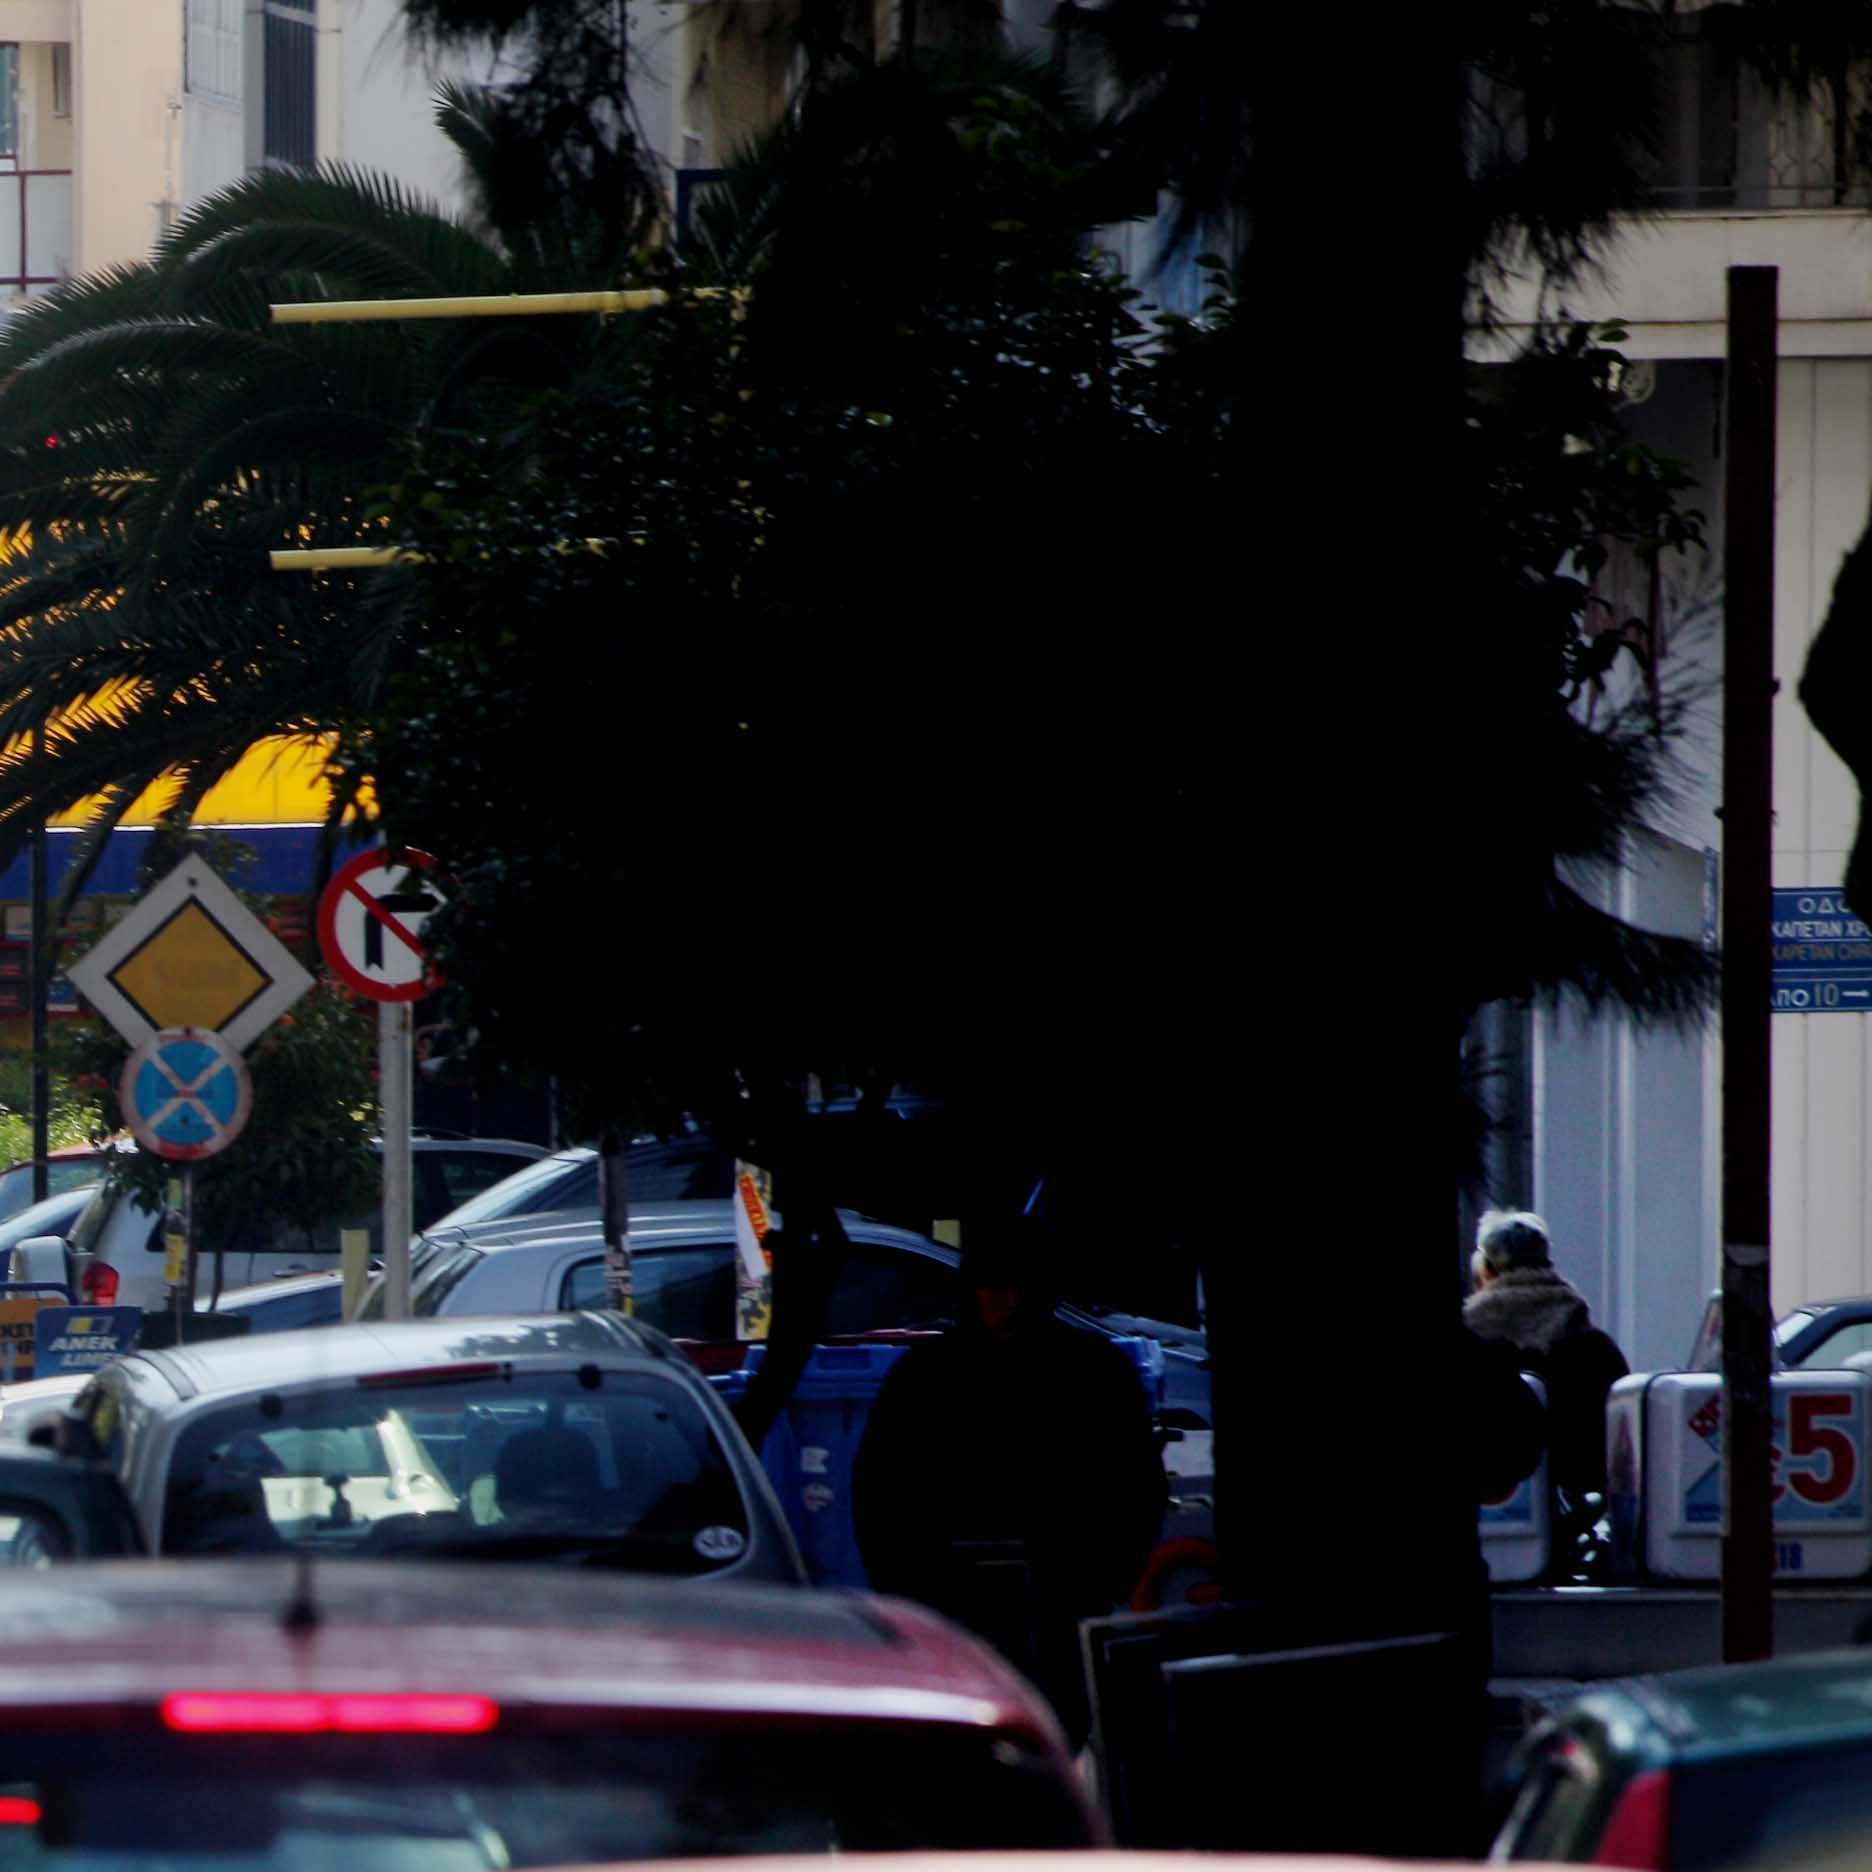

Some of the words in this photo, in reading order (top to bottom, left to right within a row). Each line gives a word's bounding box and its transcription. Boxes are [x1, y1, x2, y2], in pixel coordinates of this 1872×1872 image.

[1797, 896, 1853, 914] ΟΔΟ
[1813, 983, 1839, 1006] 10
[48, 1336, 120, 1351] ANEK
[1774, 1393, 1856, 1504] 5
